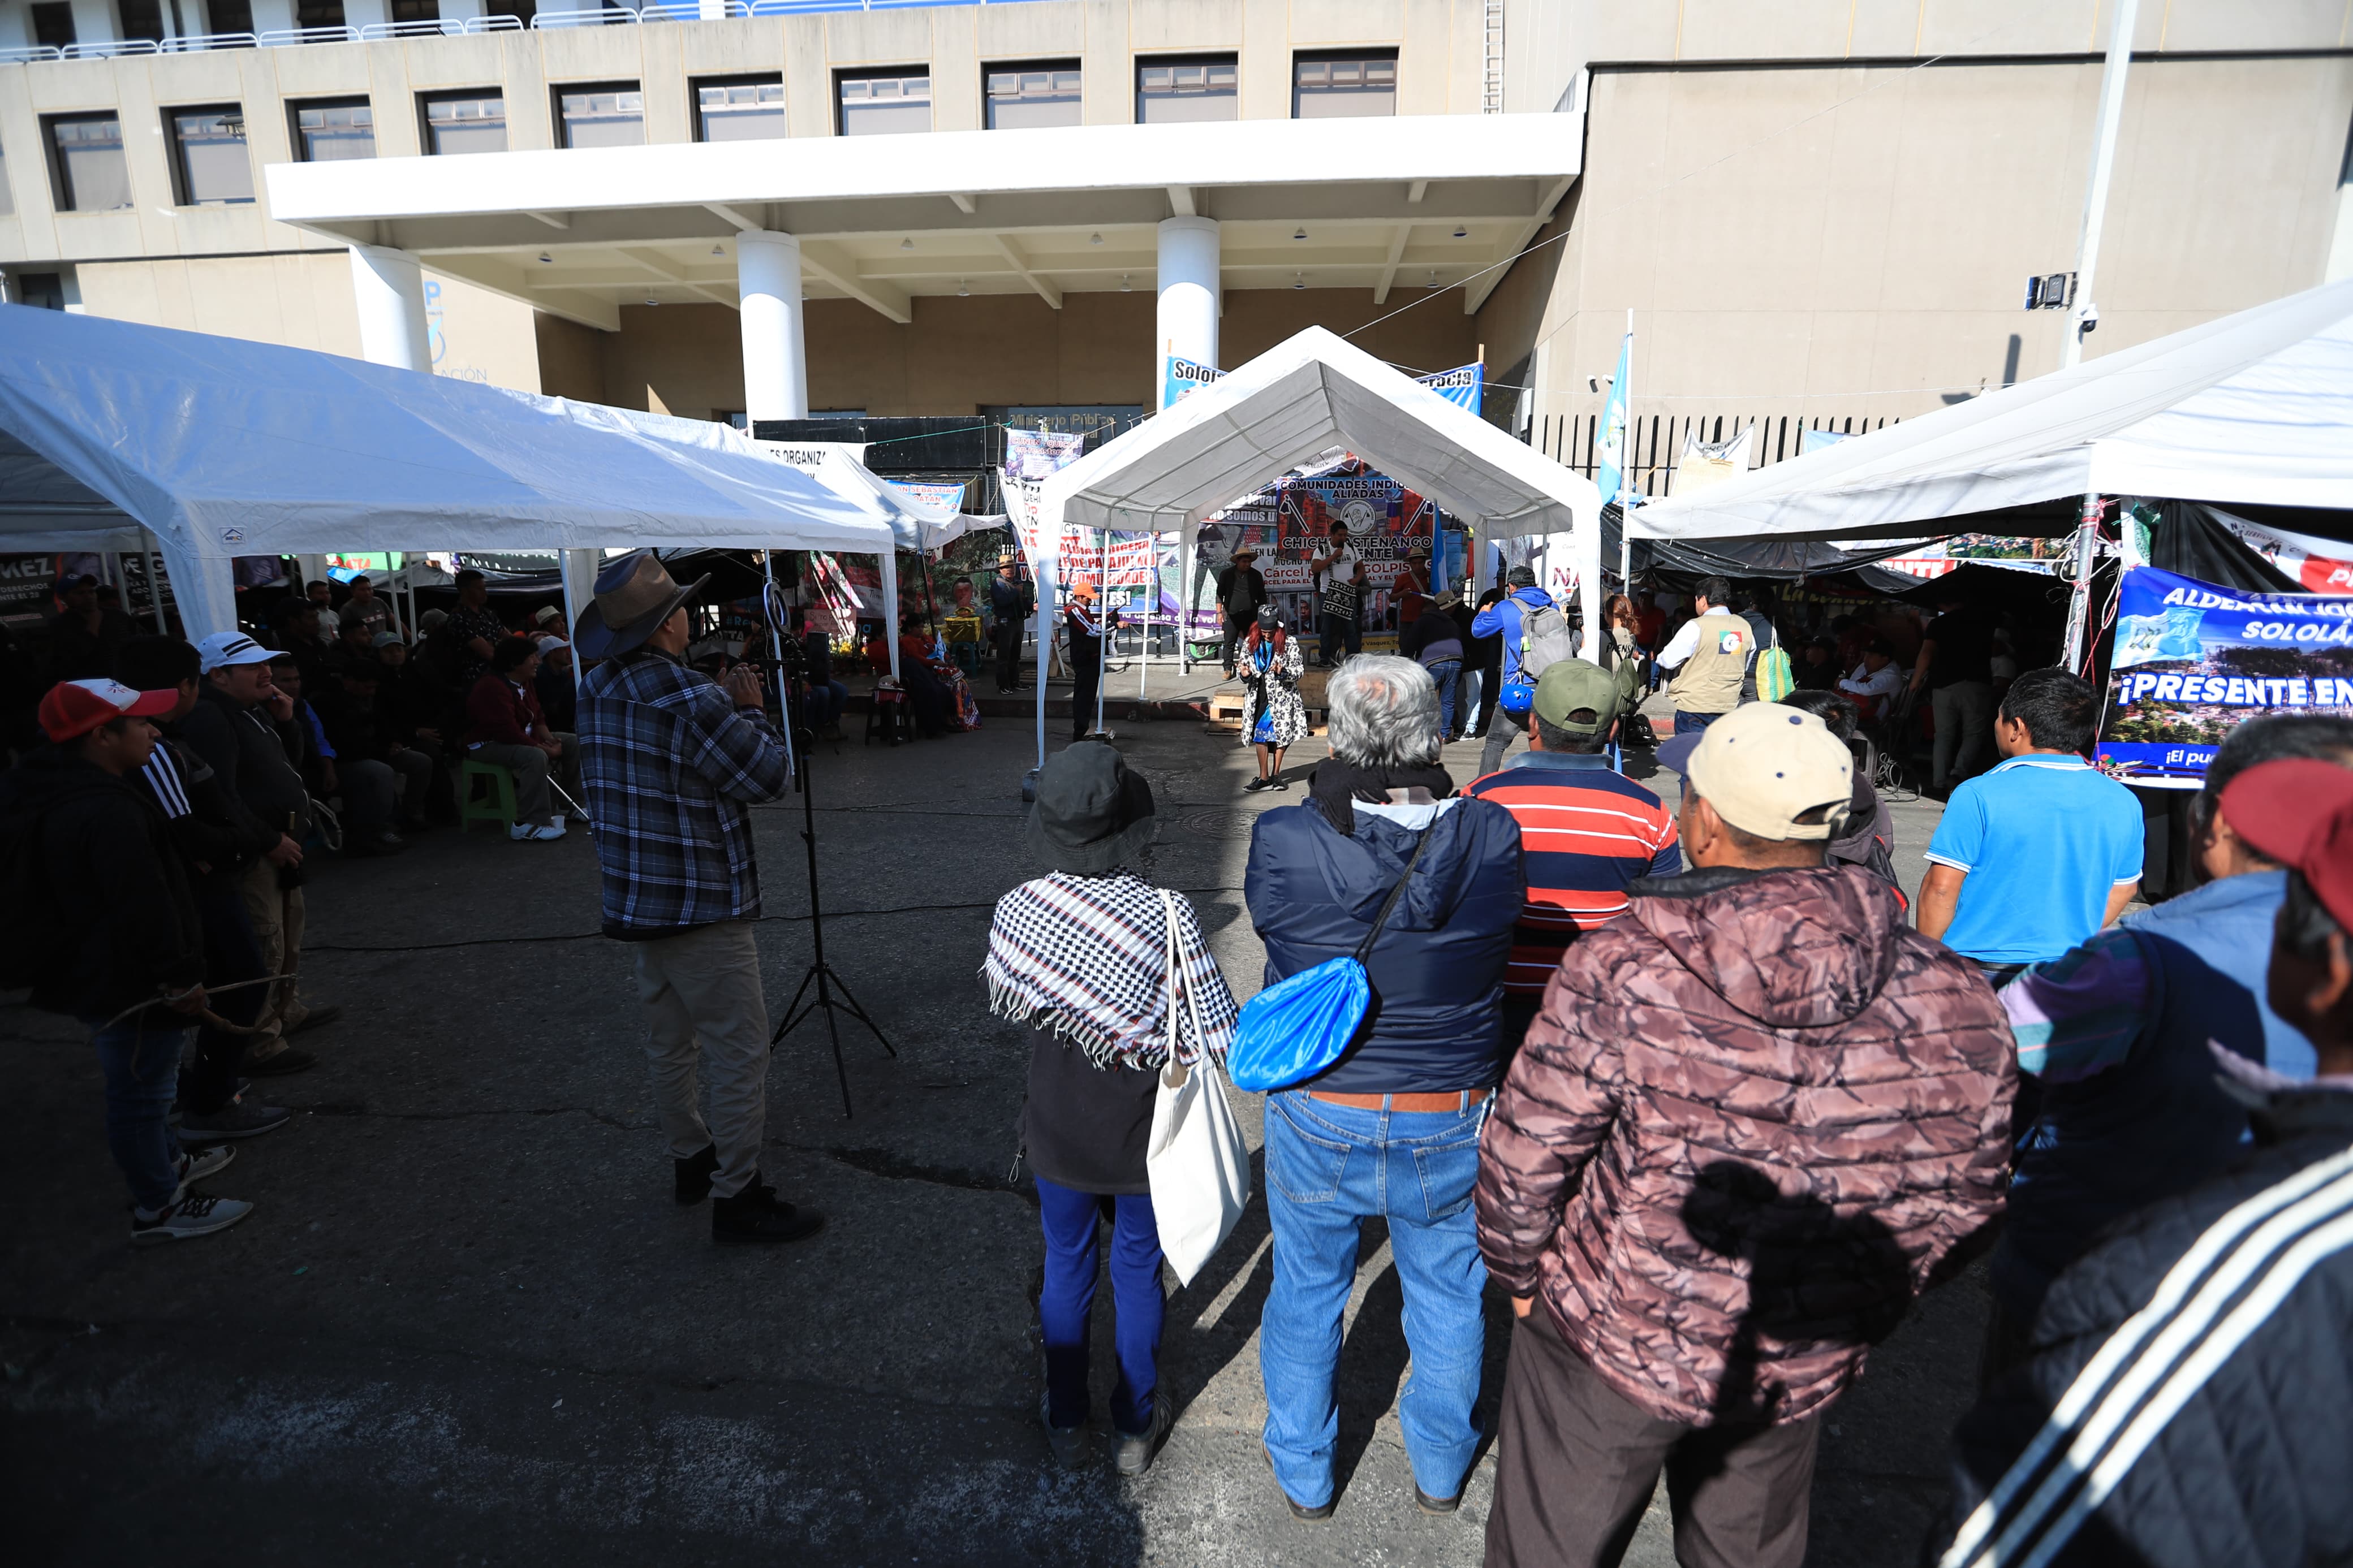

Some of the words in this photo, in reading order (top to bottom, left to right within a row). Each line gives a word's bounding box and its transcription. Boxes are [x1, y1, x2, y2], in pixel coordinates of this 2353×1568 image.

[1013, 414, 1066, 425] Miniserio
[1281, 481, 1368, 490] COMUNIDADES
[1332, 490, 1384, 498] ALIADAS
[1226, 510, 1265, 521] somos
[1264, 567, 1303, 578] Cárcel
